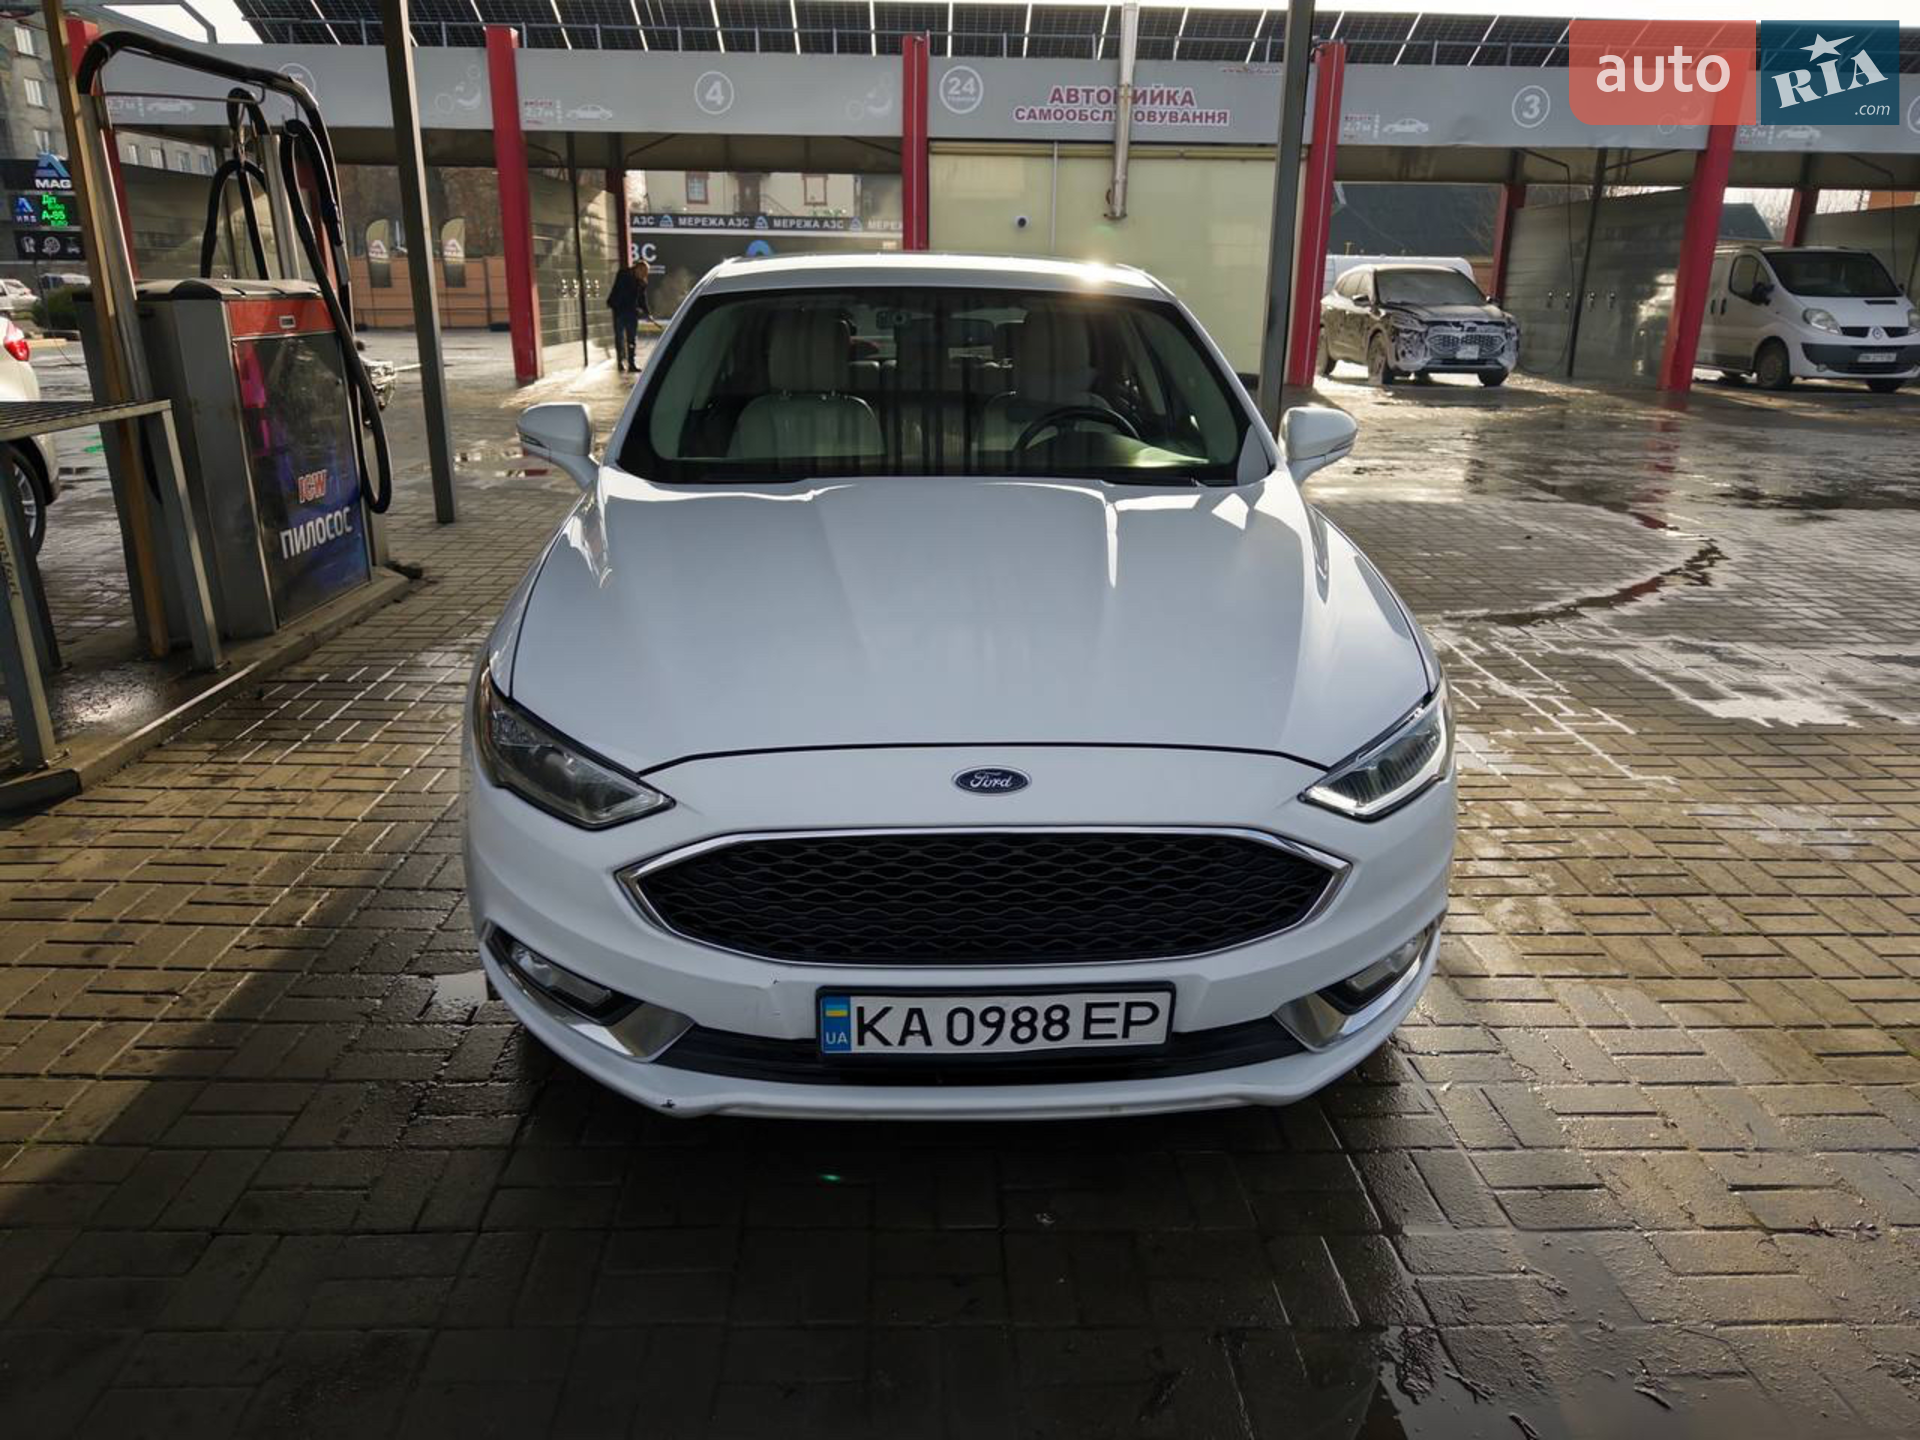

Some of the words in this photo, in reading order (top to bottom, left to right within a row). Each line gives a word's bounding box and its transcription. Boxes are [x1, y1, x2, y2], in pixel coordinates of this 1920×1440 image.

[706, 80, 724, 105] 4
[948, 77, 975, 95] 24
[1014, 107, 1228, 124] САМООБСЛОВУВАННЯ
[1522, 94, 1540, 119] 3
[633, 216, 655, 225] АЗС
[678, 216, 726, 227] МЕРЕЖА
[728, 218, 750, 227] АЗС
[773, 218, 820, 229] МЕРЕЖА
[823, 219, 844, 229] АЗС
[280, 506, 353, 559] ПИЛОСОС
[970, 771, 1013, 788] Ford
[856, 1006, 932, 1047] KA
[946, 1004, 1071, 1047] 0988
[1083, 1001, 1160, 1041] EP
[825, 1032, 848, 1045] UA
